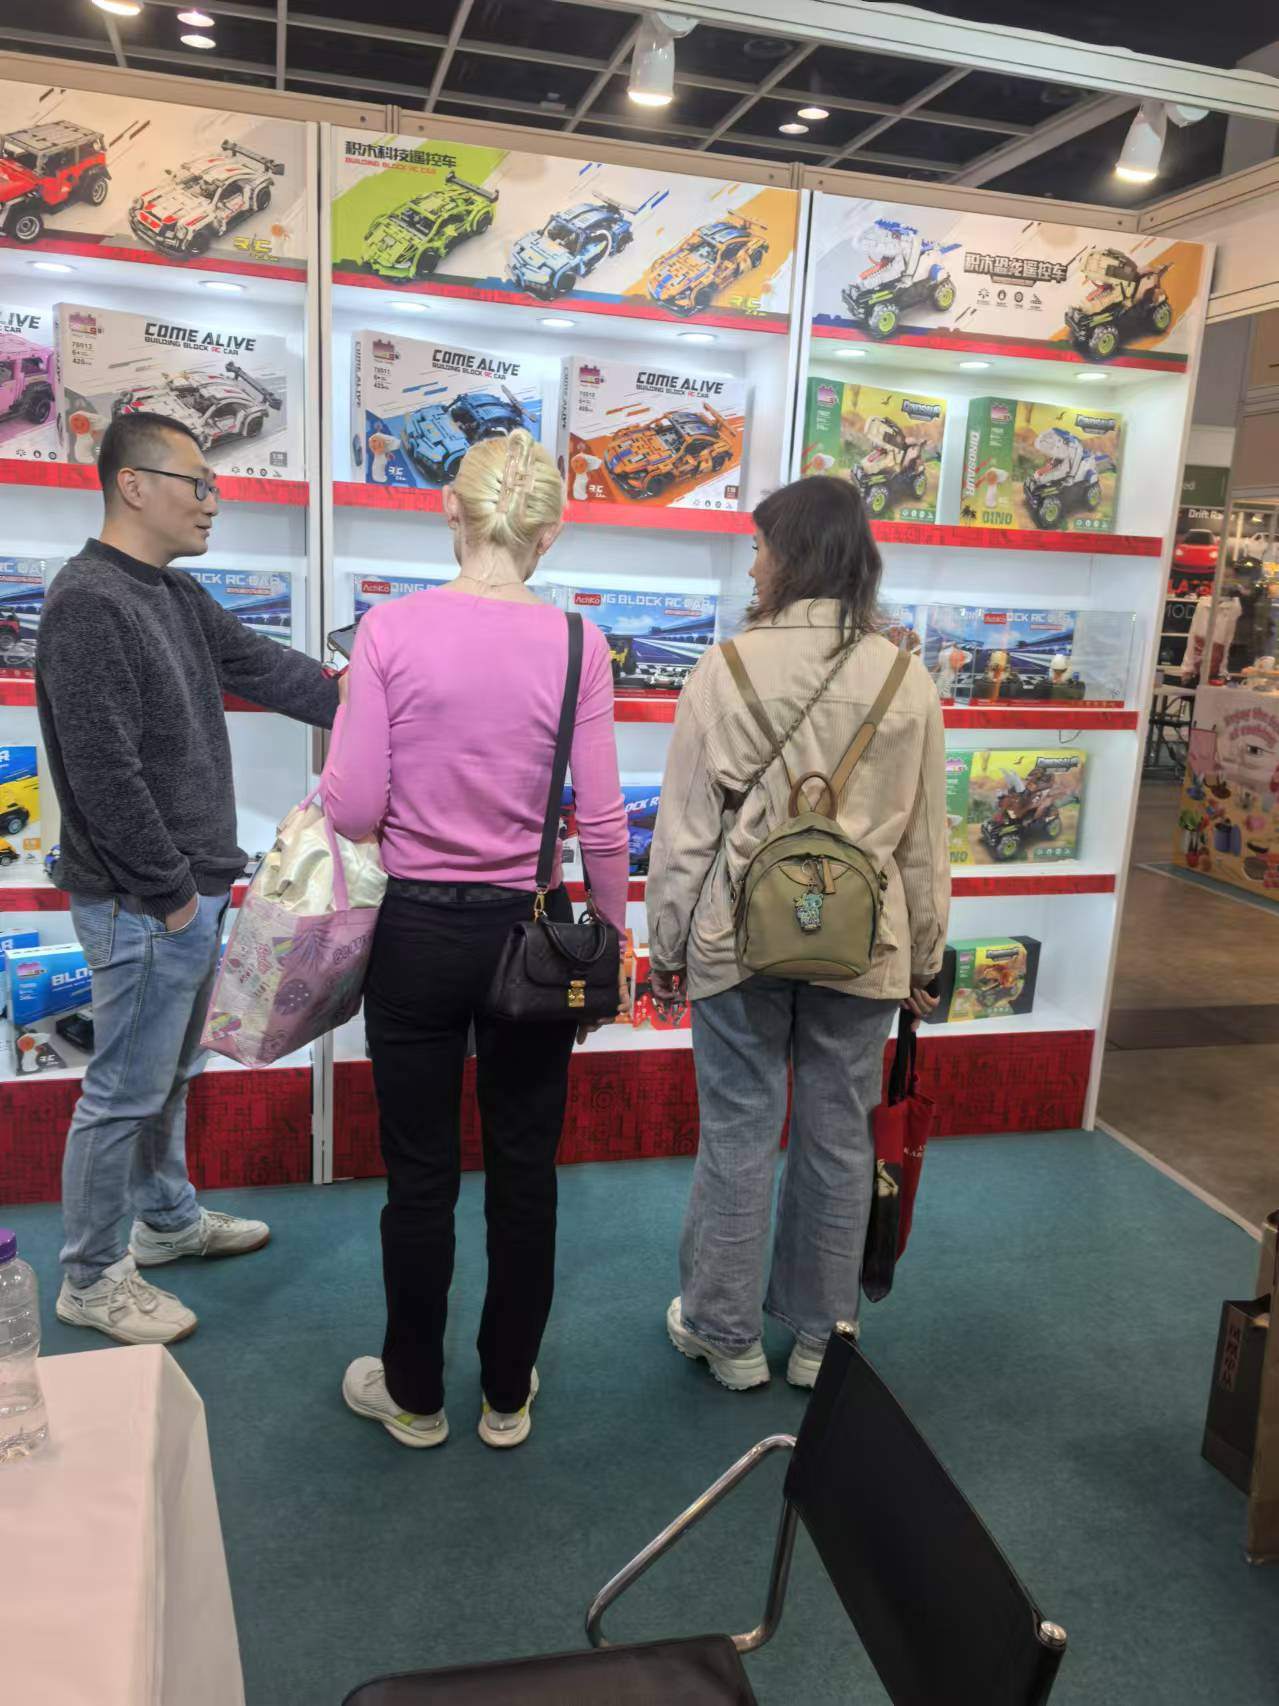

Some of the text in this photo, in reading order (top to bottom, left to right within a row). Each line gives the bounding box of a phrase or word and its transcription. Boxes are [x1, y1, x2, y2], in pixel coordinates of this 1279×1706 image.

[144, 322, 256, 351] COME ALIVE
[144, 336, 181, 348] BUILDING
[182, 343, 209, 352] BLOCK
[223, 348, 239, 356] CAR
[432, 349, 521, 377] COME ALIVE
[636, 371, 724, 394] COME ALIVE
[225, 574, 246, 585] RC
[618, 594, 662, 606] BLOCK
